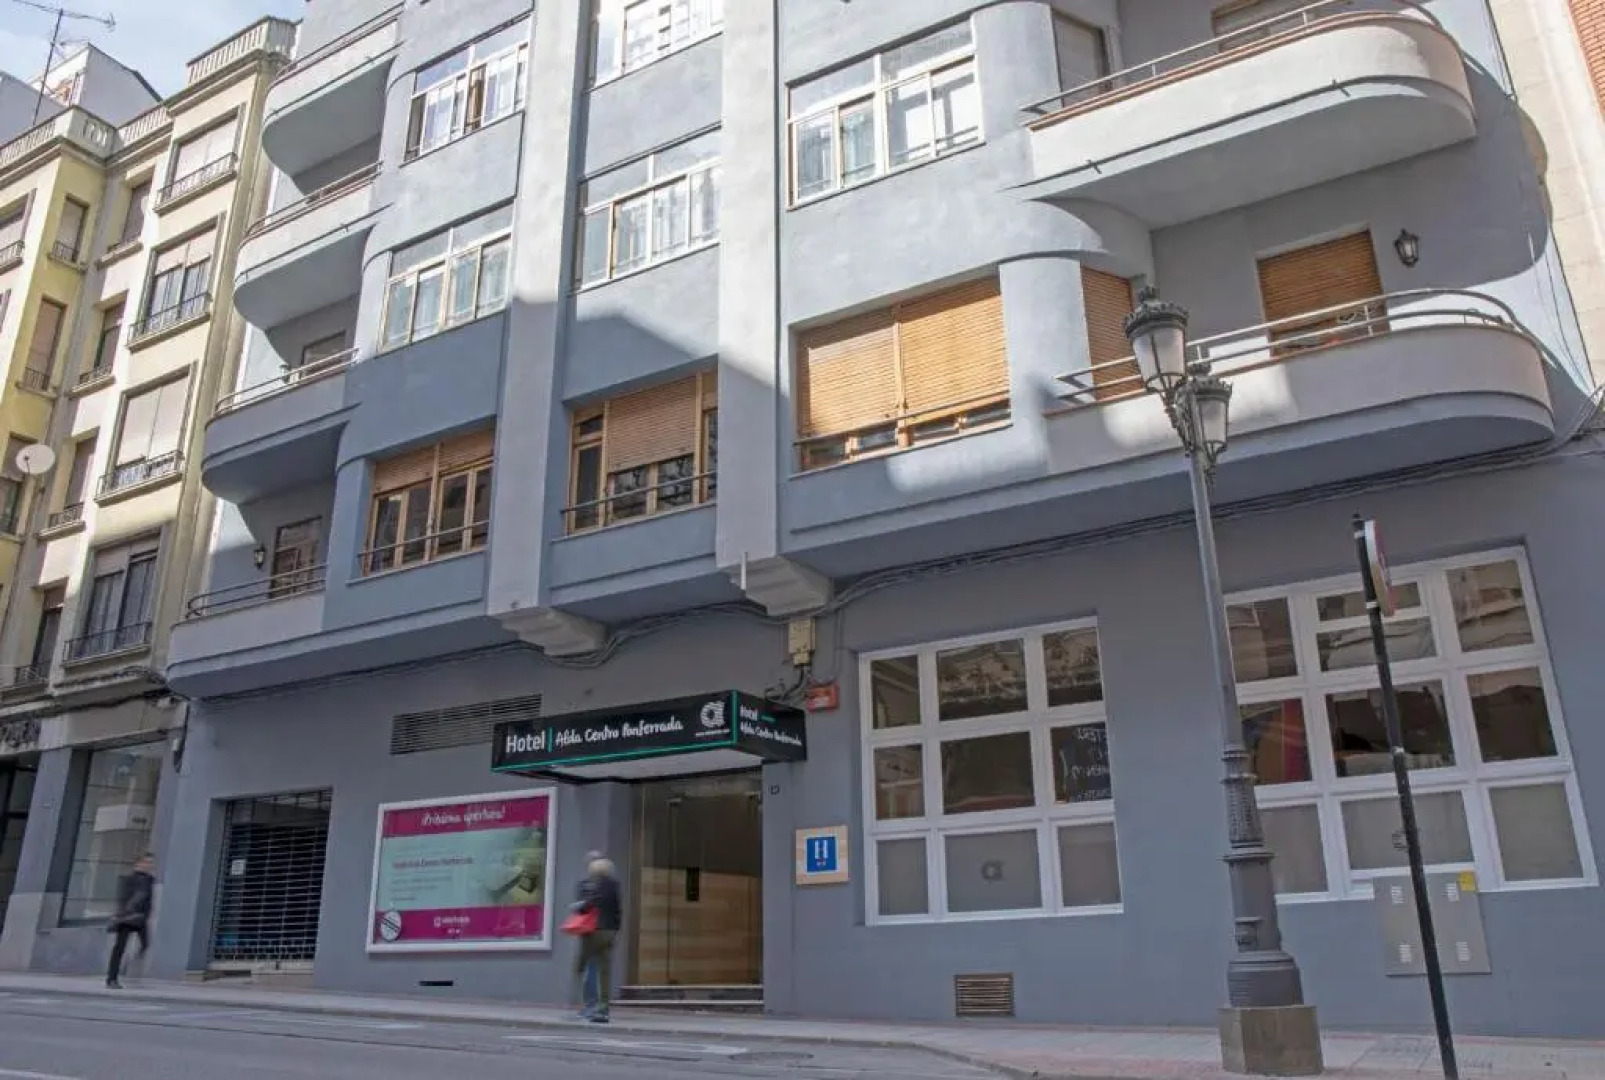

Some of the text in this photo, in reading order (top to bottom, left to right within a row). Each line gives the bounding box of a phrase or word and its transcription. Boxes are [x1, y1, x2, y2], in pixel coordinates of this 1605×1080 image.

[506, 714, 684, 753] Hotel Alda Centro Ponferrada
